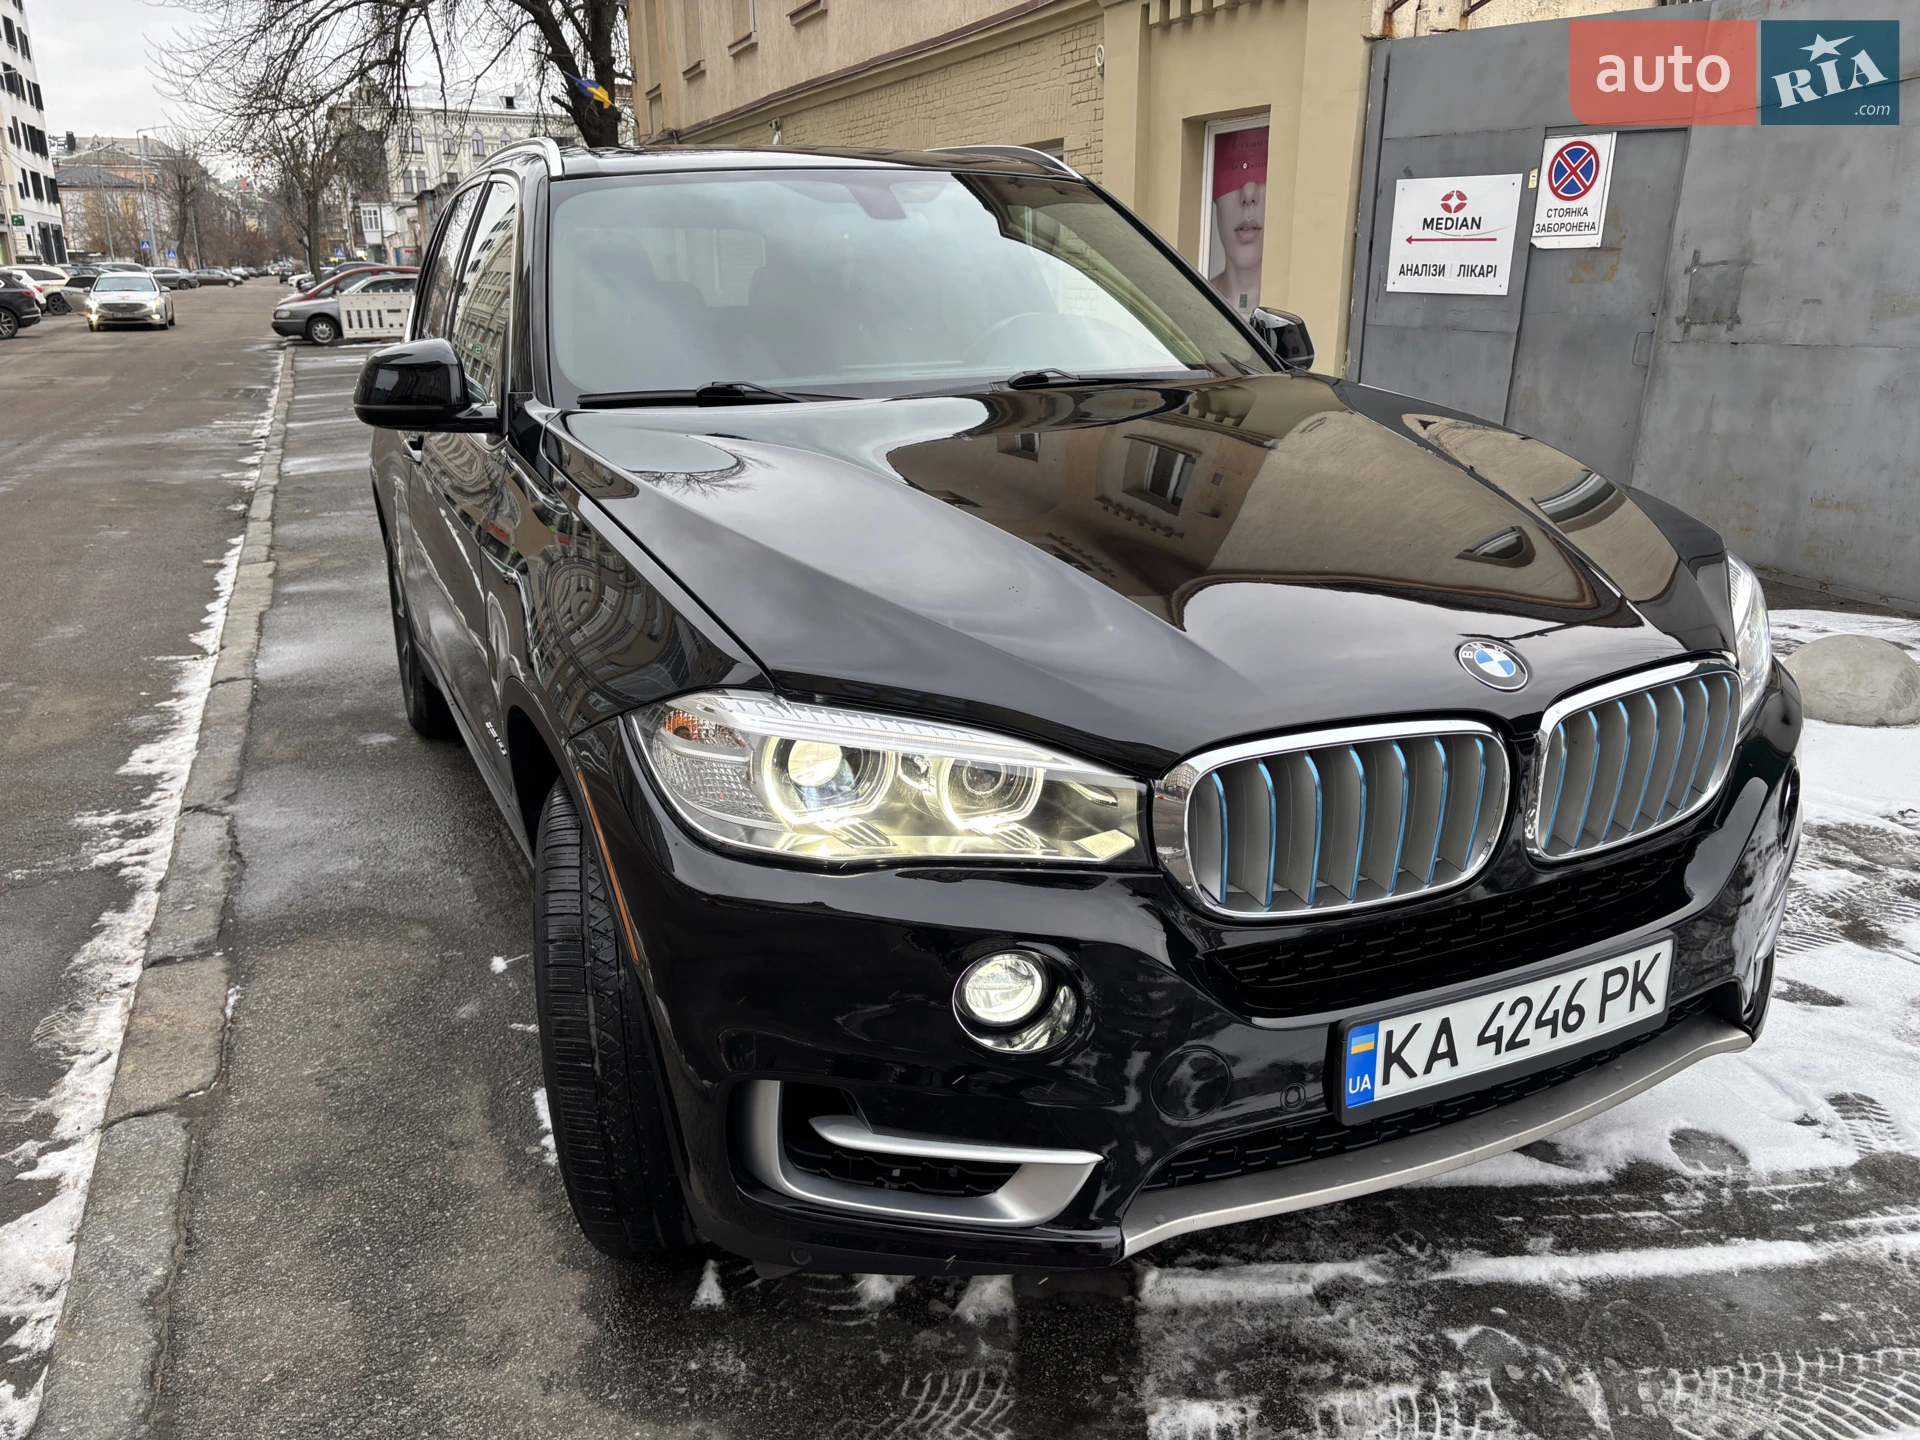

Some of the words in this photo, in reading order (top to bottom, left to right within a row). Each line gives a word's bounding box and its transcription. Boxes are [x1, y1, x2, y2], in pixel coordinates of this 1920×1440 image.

[1546, 206, 1588, 218] СТОЯНКА
[1422, 216, 1482, 231] MEDIAN
[1535, 221, 1596, 234] ЗАБОРОНЕНА
[1398, 263, 1446, 278] АНАЛІЗИ
[1456, 264, 1498, 278] ЛІКАРІ
[1476, 977, 1588, 1056] 4246
[1348, 1073, 1372, 1094] UA
